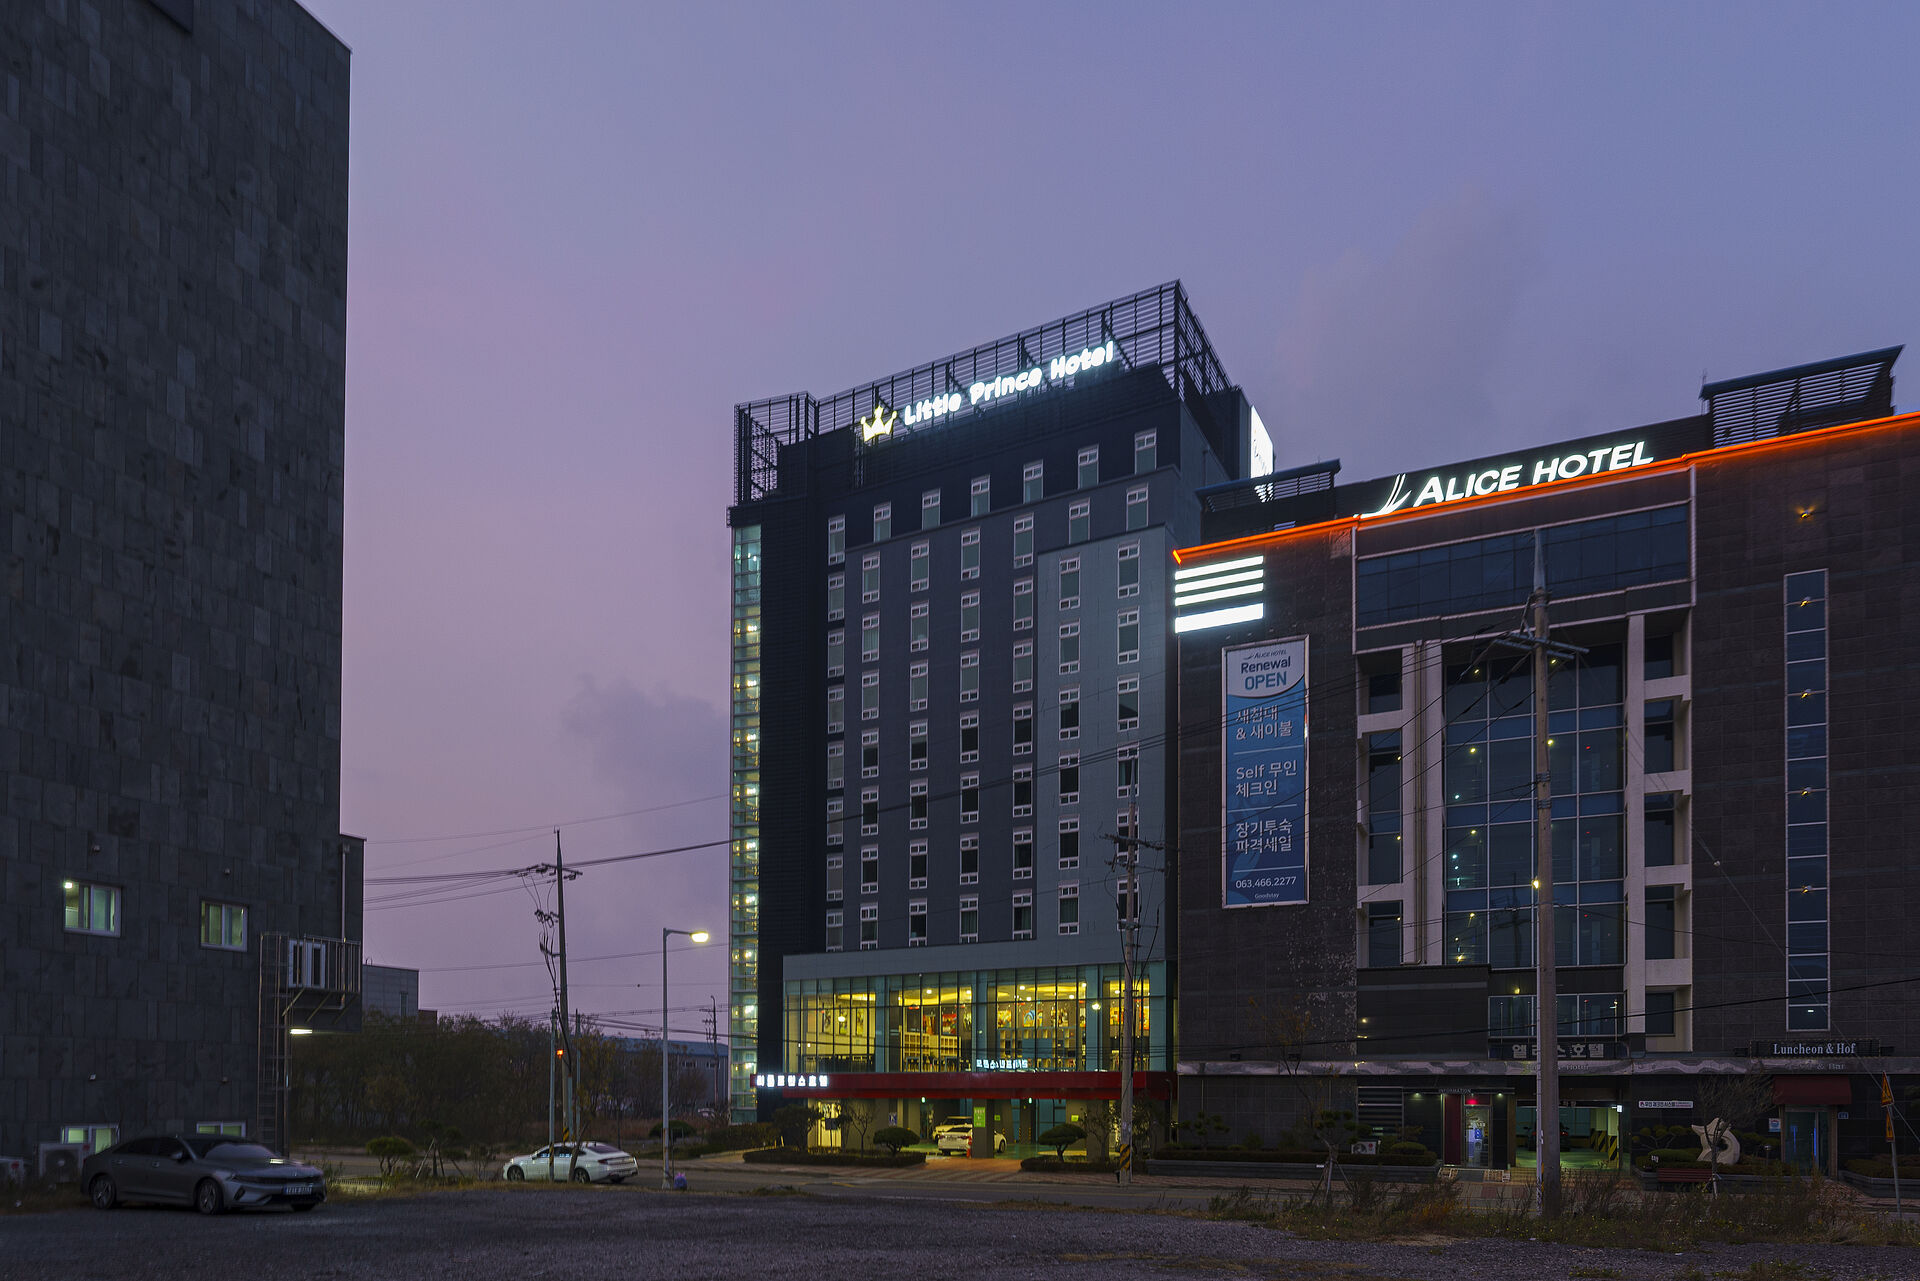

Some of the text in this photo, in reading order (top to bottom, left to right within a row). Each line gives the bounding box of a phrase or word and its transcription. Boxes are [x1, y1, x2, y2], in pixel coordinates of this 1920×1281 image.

[904, 340, 1114, 426] Little Prince Hotel
[1413, 441, 1654, 507] ALICE HOTEL
[1254, 651, 1270, 659] ALICE
[1241, 656, 1291, 674] Renewal
[1244, 671, 1287, 691] OPEN
[1236, 720, 1293, 740] & 새이불
[1236, 759, 1297, 780] Self 무인
[1236, 779, 1278, 798] 체크인
[1236, 818, 1292, 839] 장기투숙
[1236, 835, 1292, 854] 파격세일
[1235, 876, 1297, 889] 063.466.2277
[1773, 1042, 1857, 1055] Luncheon & Hof
